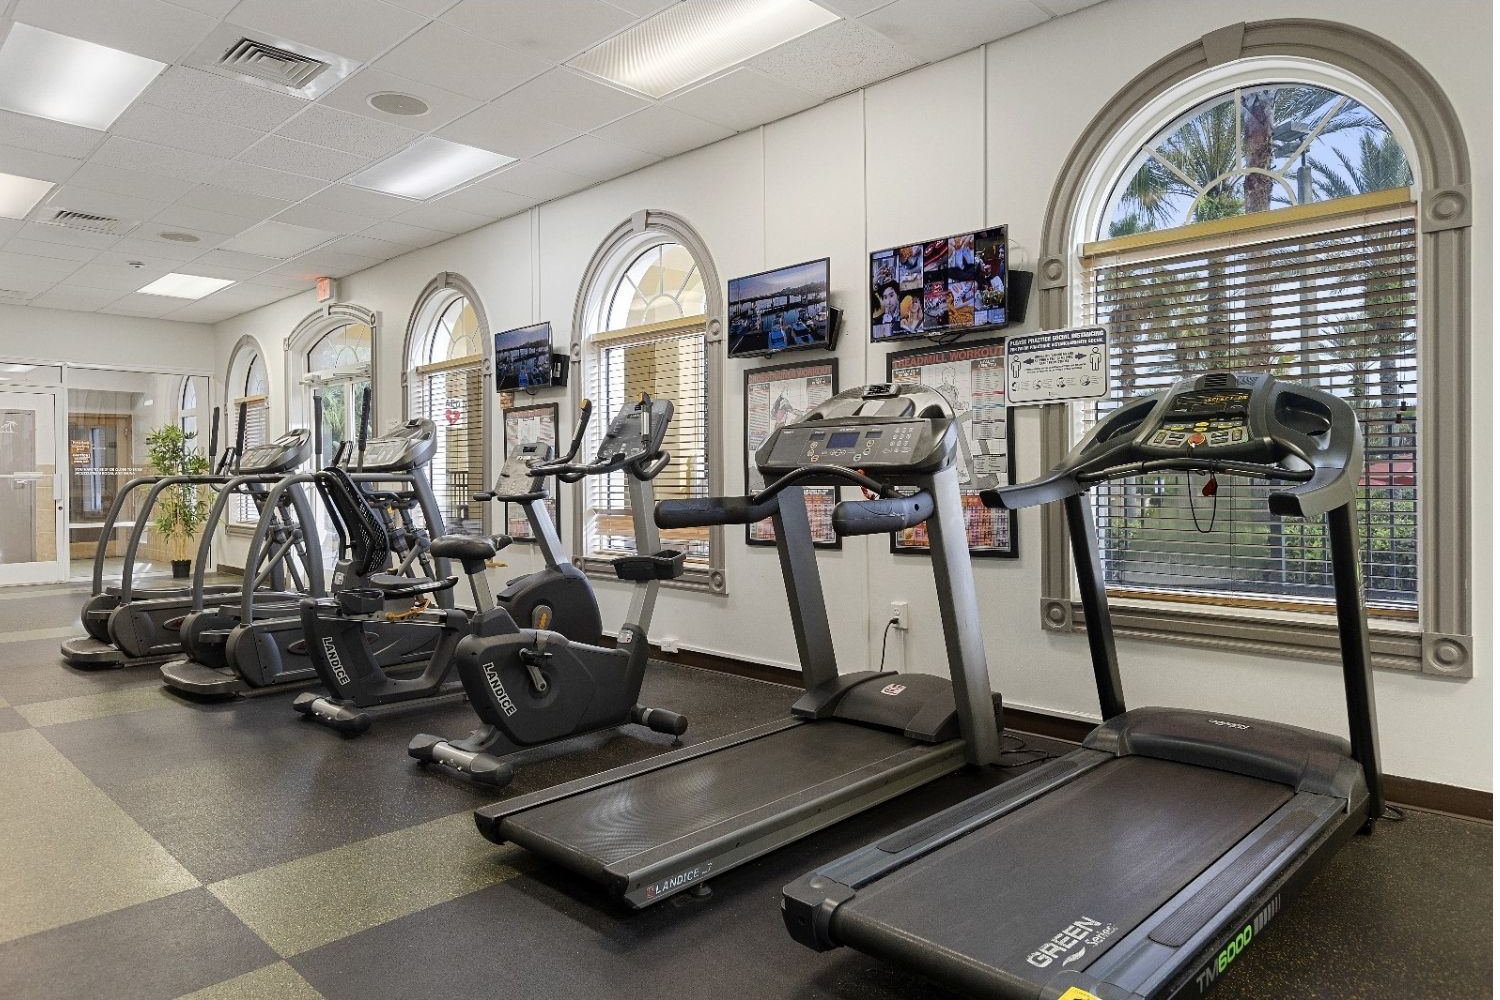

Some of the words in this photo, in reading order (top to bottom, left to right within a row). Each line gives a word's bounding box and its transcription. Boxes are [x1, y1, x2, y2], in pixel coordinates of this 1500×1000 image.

[894, 353, 945, 369] TREADMILL
[949, 345, 1004, 360] WORKOUT
[1028, 335, 1052, 344] PRACTICE
[1052, 333, 1070, 342] SOCIAL
[1071, 329, 1104, 339] DISTANCING
[322, 637, 351, 686] LANDICE
[482, 661, 518, 717] LANDICE
[655, 868, 700, 895] LANDICE
[1026, 916, 1102, 968] GREEN
[1196, 925, 1253, 993] TM6000
